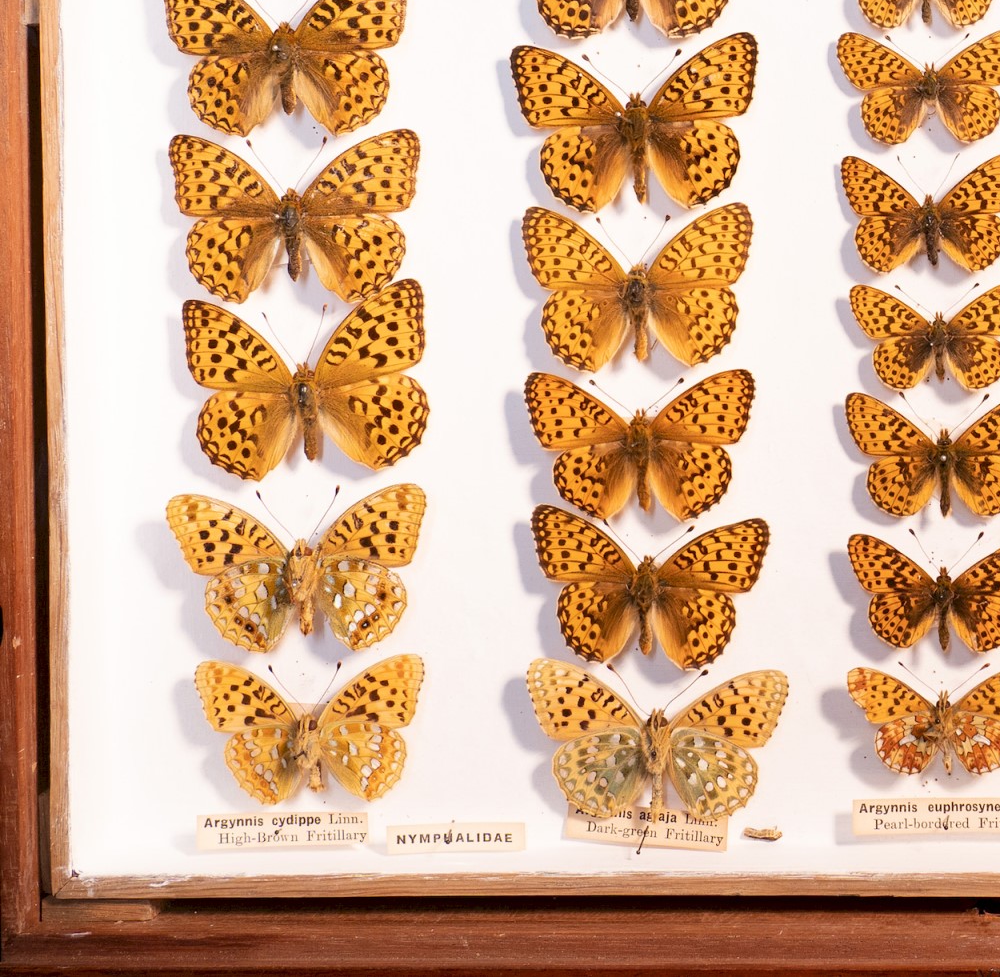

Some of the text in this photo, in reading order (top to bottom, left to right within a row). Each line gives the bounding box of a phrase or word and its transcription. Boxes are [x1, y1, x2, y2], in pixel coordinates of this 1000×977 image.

[859, 802, 918, 814] Argynnis
[927, 801, 1000, 814] euphrosyne
[203, 813, 364, 829] Argynnis cydippe Linn.
[640, 810, 677, 824] agaja
[873, 817, 970, 830] Pearl-bordered
[218, 829, 367, 846] High-Brown Fritillary
[396, 833, 512, 845] NYMPHALIDAE
[586, 820, 724, 847] Dark-green Fritillary
